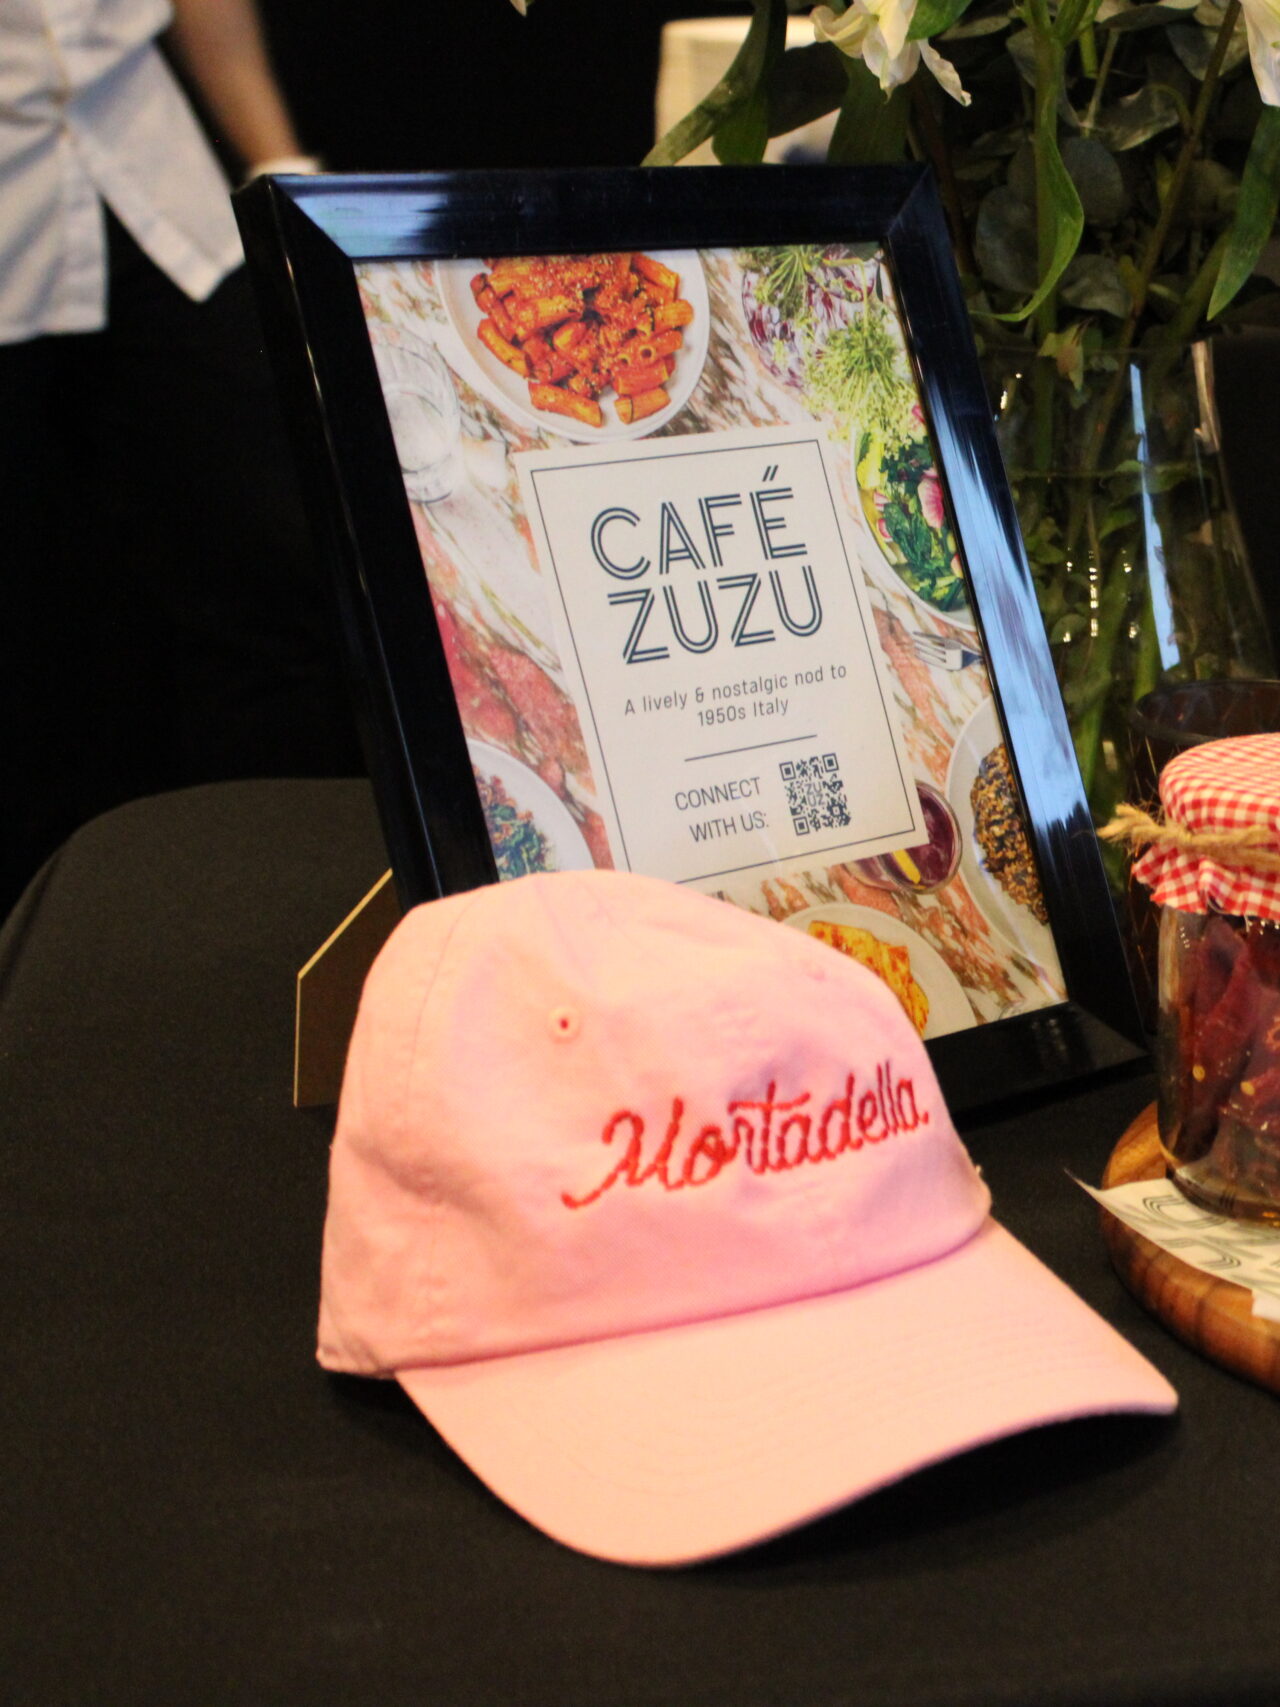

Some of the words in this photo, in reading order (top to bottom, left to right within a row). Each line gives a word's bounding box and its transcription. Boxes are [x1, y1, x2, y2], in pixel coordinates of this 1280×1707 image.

[590, 465, 808, 580] CAFÉ
[607, 565, 823, 665] ZUZU
[624, 699, 636, 716] A
[642, 688, 688, 714] lively
[694, 687, 706, 703] &
[712, 674, 789, 703] nostalgic
[794, 666, 824, 686] nod
[831, 665, 848, 680] to
[697, 704, 747, 727] 1950s
[753, 698, 790, 719] Italy
[674, 777, 762, 811] CONNECT
[688, 815, 737, 843] WITH
[740, 811, 770, 834] US:
[560, 1059, 930, 1210] Mortadella
